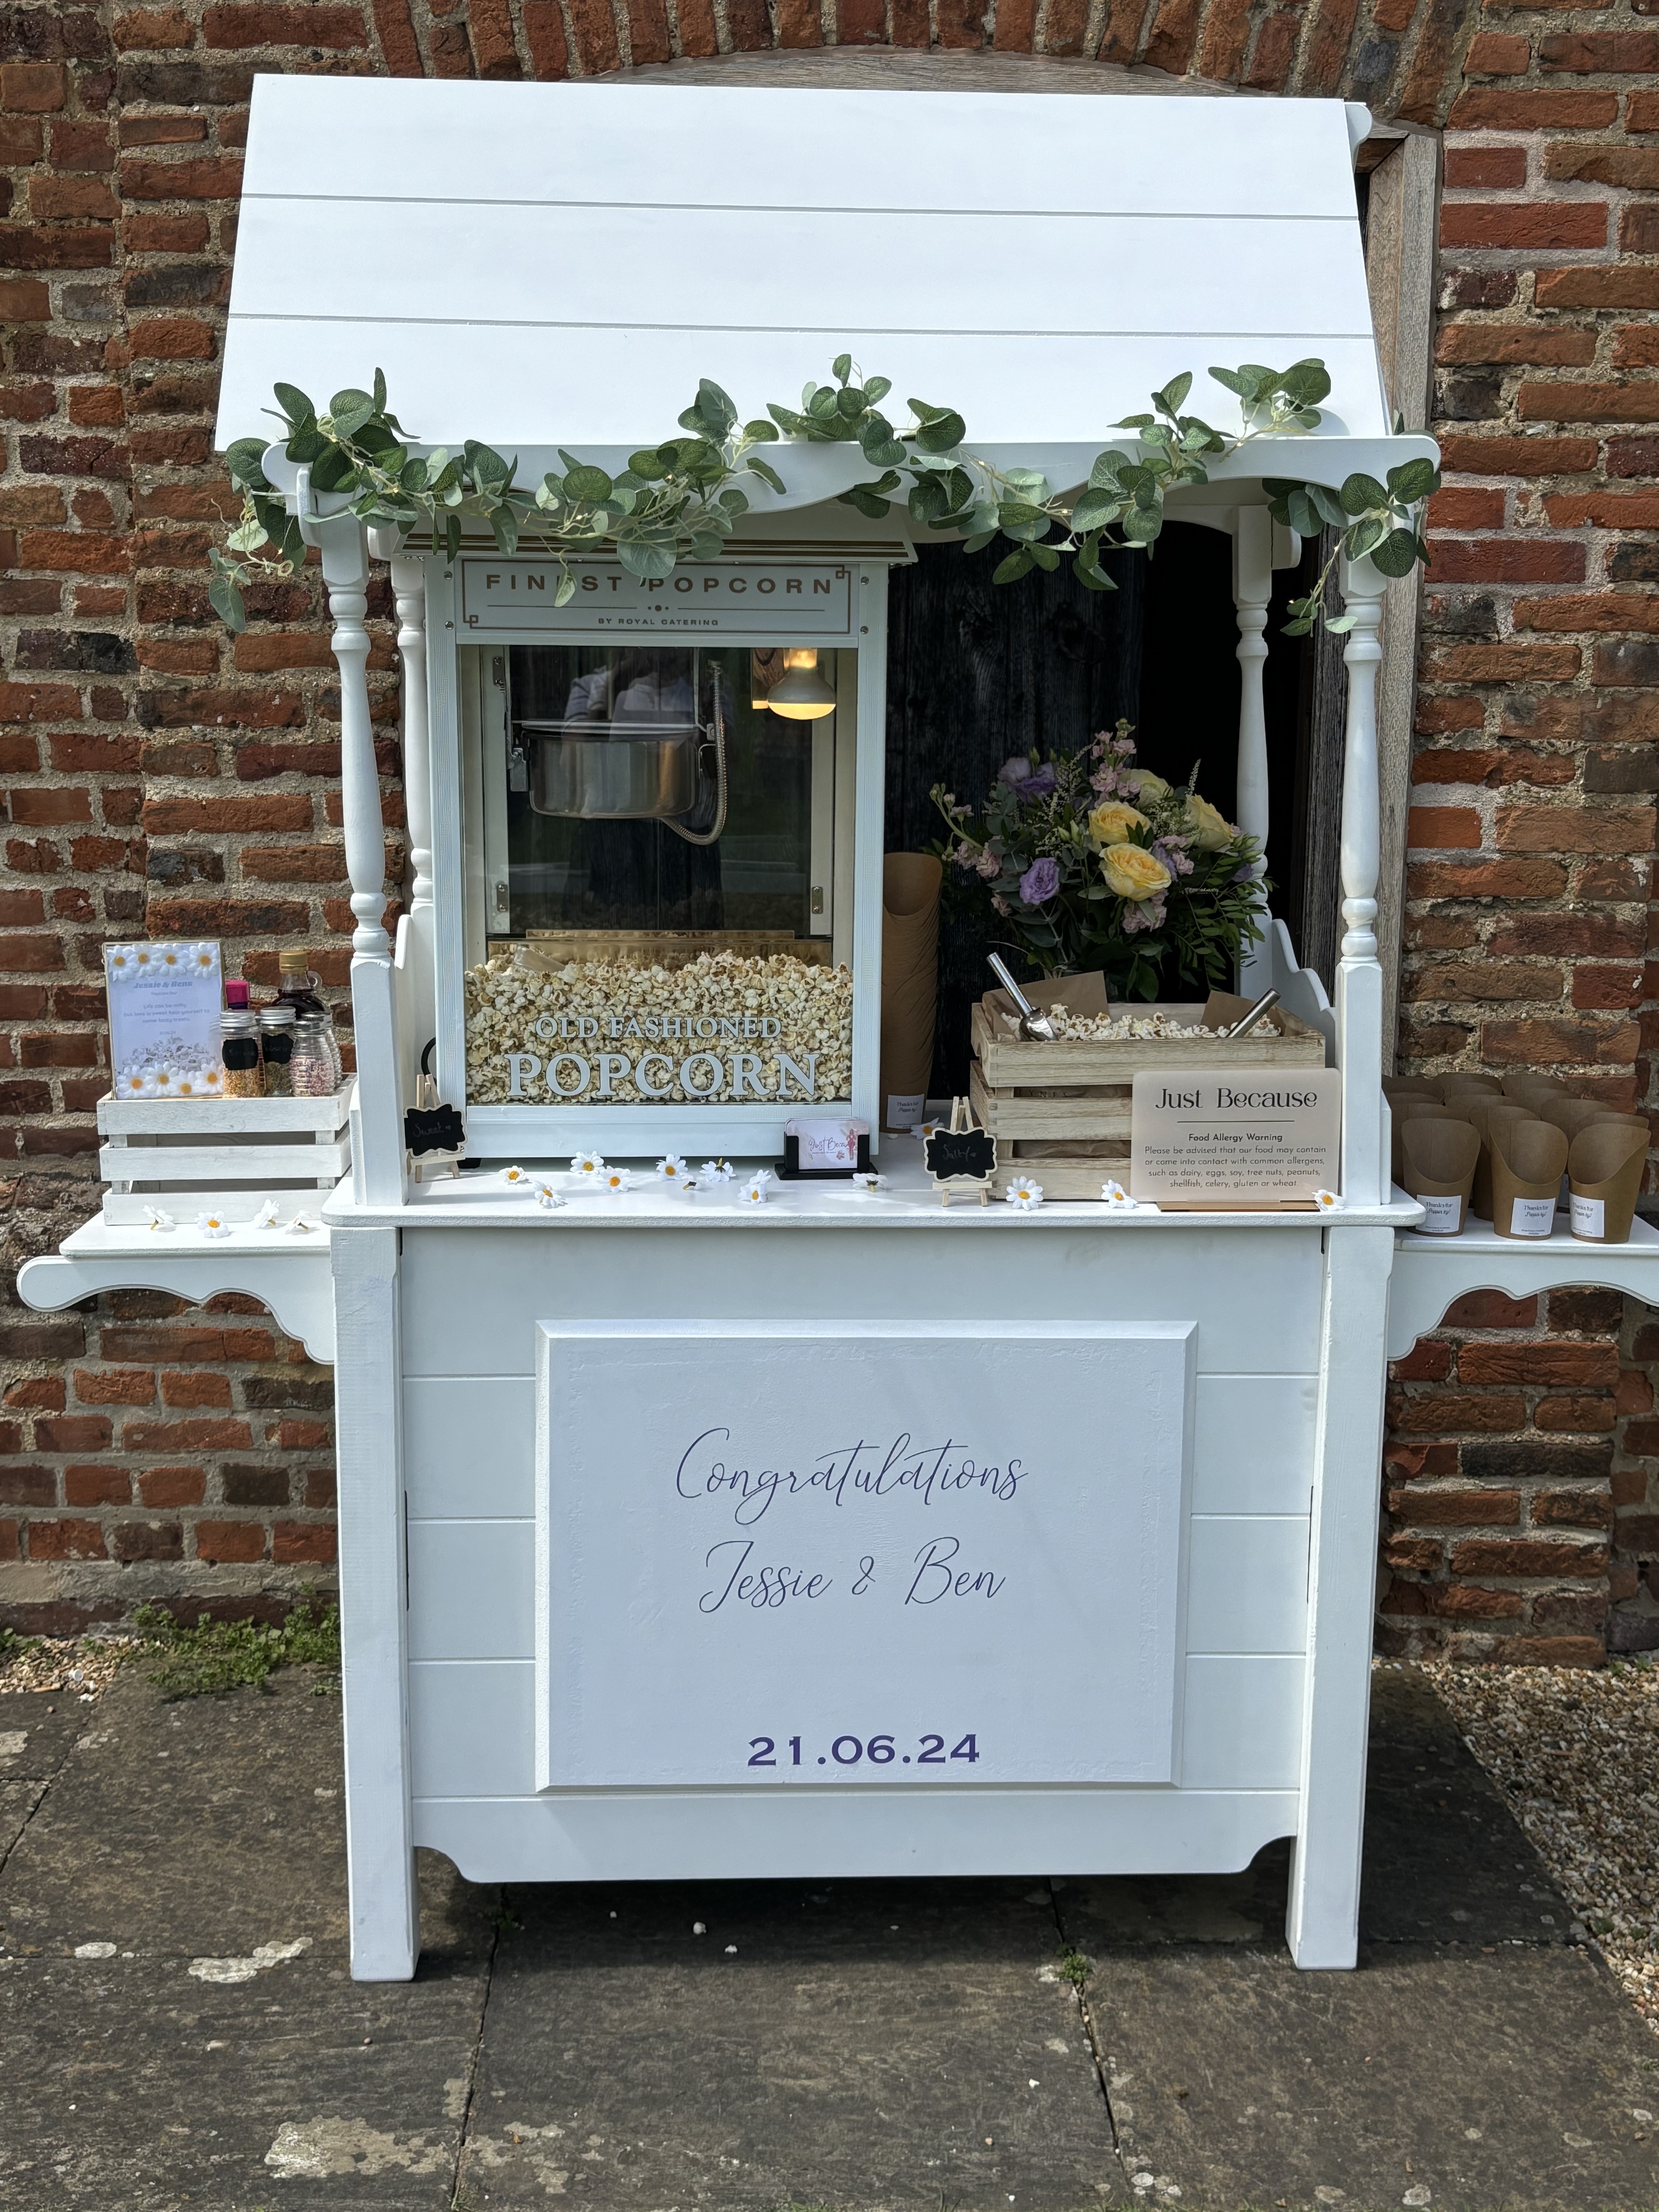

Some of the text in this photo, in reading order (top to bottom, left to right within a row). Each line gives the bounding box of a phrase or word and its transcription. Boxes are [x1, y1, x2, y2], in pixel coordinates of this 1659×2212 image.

[486, 574, 831, 594] FINST POPCORN
[535, 1016, 781, 1039] OLD FASHIONED
[504, 1053, 819, 1097] POPCORN
[1155, 1088, 1317, 1109] Just Because
[809, 1135, 829, 1152] Just
[1213, 1133, 1243, 1142] Allergy
[1246, 1133, 1283, 1142] Warning
[943, 1144, 970, 1162] Salty
[1145, 1146, 1170, 1154] Please
[1173, 1146, 1183, 1154] be
[1186, 1146, 1216, 1154] advised
[1220, 1145, 1236, 1153] that
[1255, 1145, 1273, 1153] food
[1231, 1156, 1247, 1164] with
[1287, 1156, 1325, 1166] allergens,
[1180, 1168, 1203, 1177] dairy,
[1170, 1179, 1202, 1188] shellfish,
[1205, 1179, 1230, 1188] celery,
[1233, 1179, 1258, 1188] gluten
[676, 1427, 1028, 1525] Congratulations
[699, 1537, 1006, 1613] Jessie & Ben
[747, 1734, 980, 1766] 21.06.24
